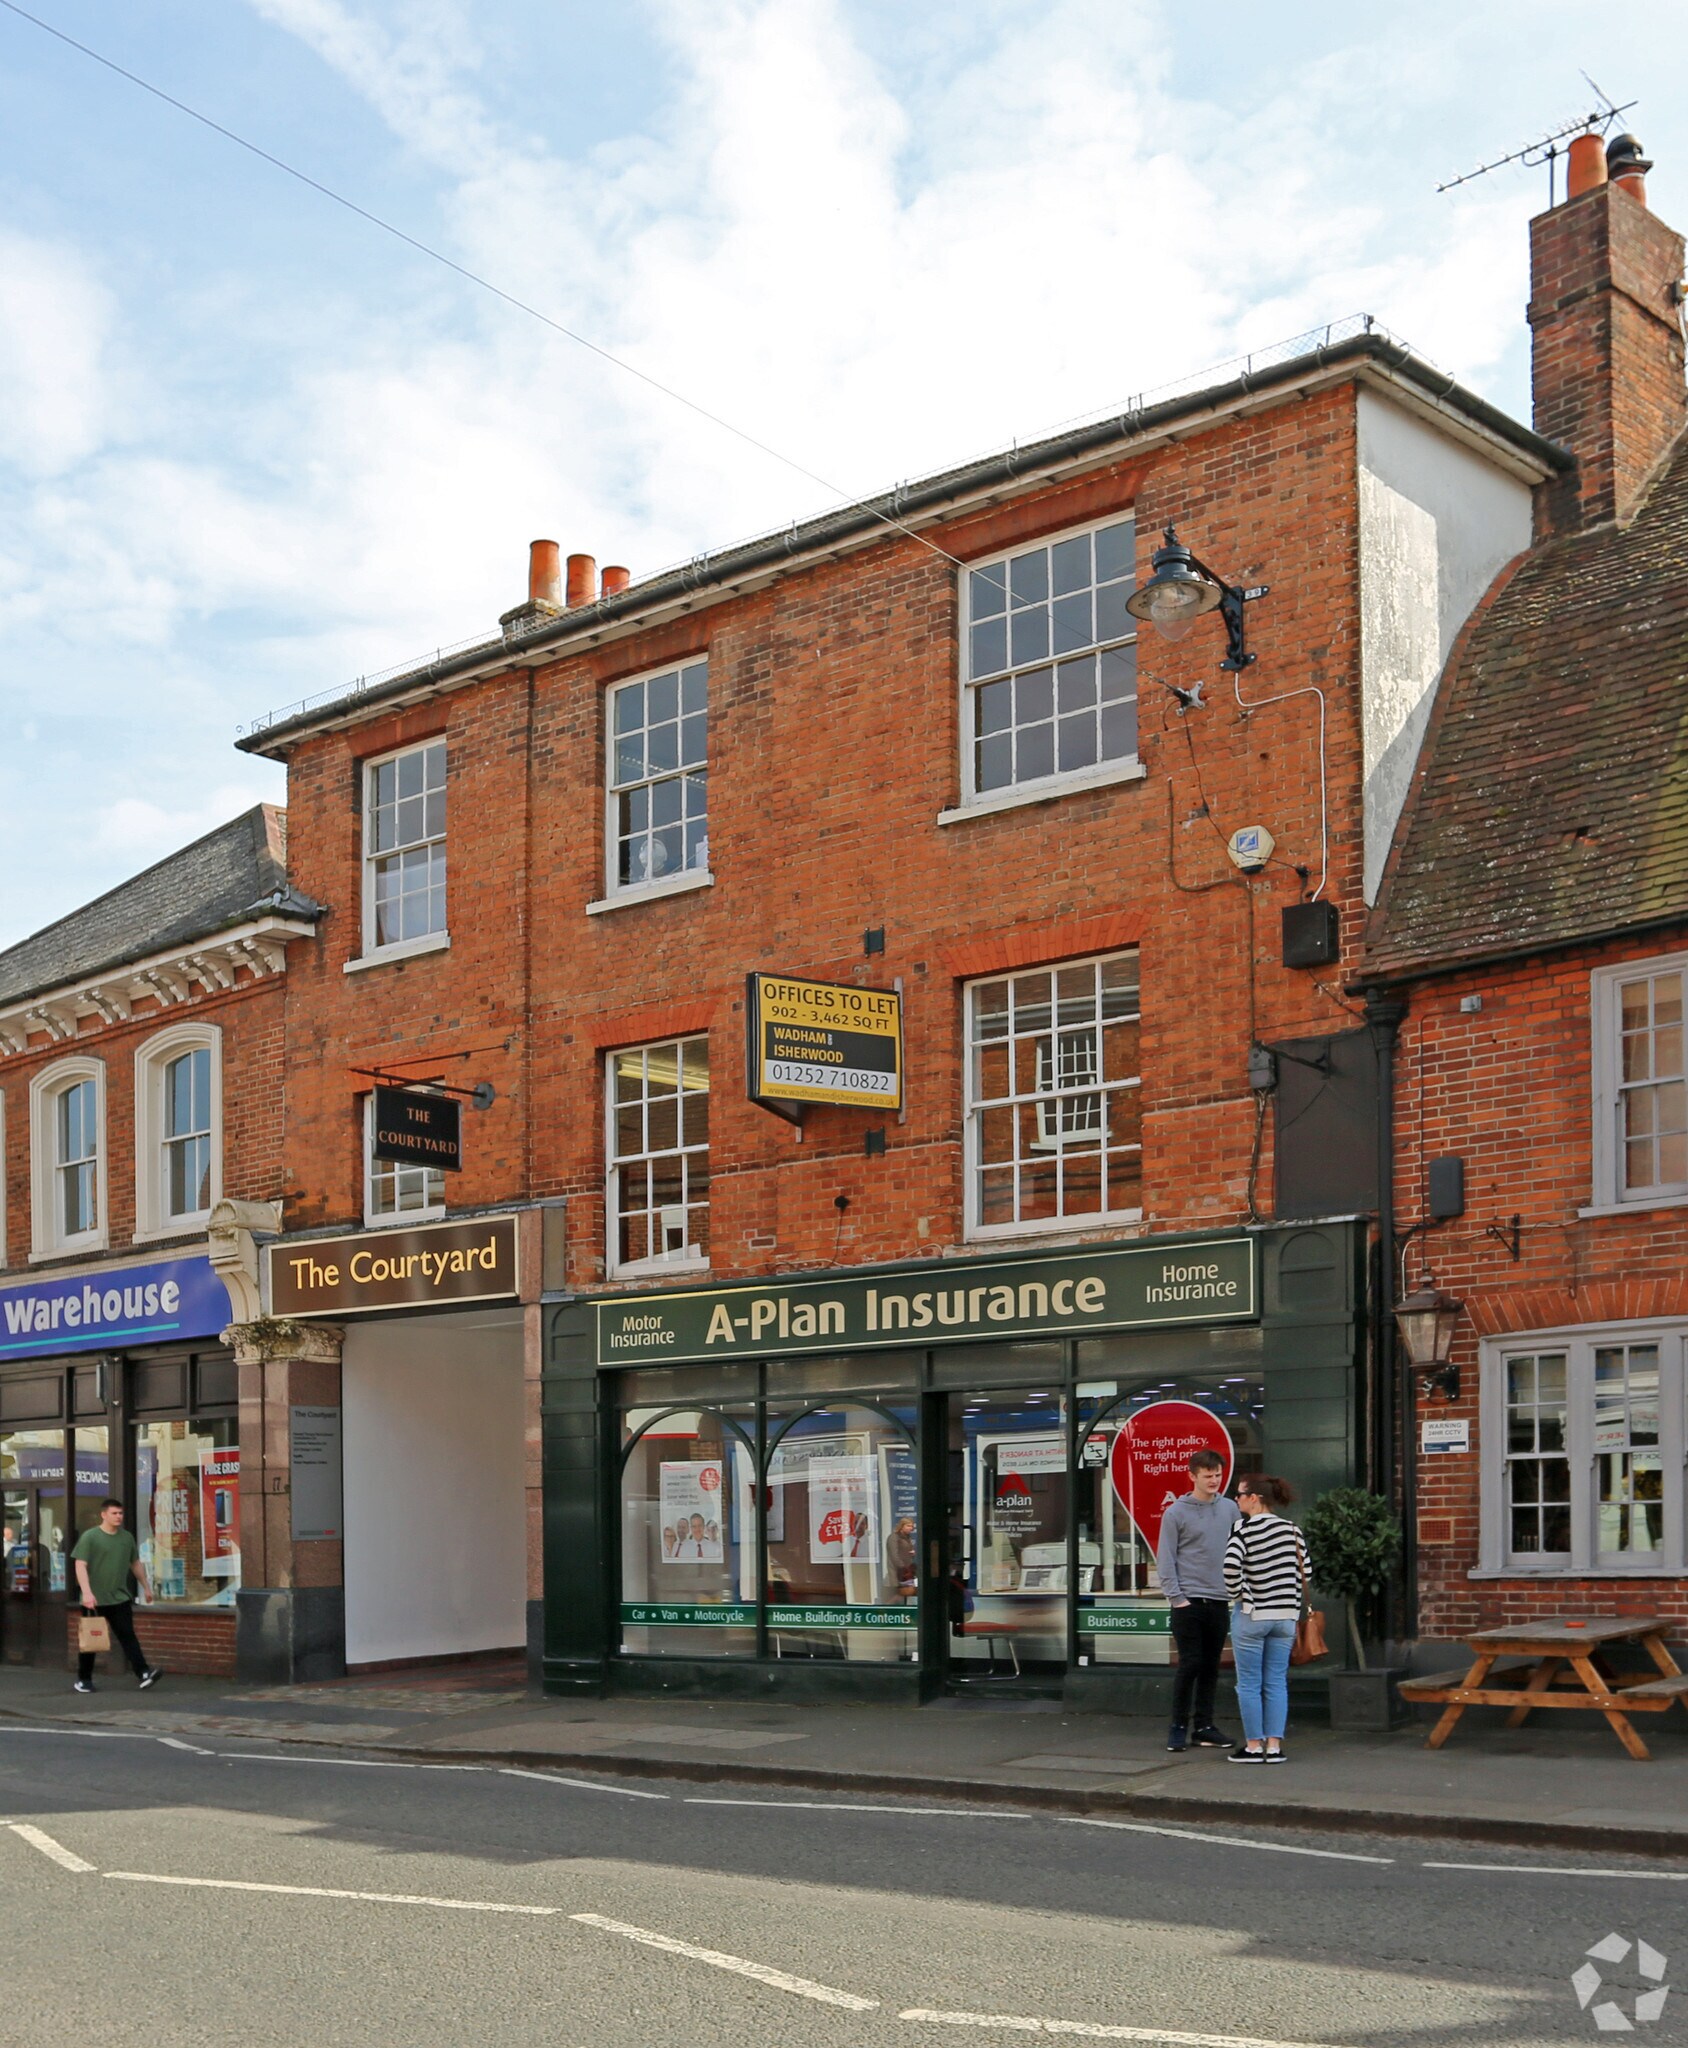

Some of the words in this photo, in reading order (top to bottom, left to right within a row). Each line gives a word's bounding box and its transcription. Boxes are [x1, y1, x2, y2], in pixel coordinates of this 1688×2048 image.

[764, 983, 835, 1007] OFFICES
[840, 993, 862, 1010] TO
[868, 997, 896, 1015] LET
[772, 1005, 798, 1019] 902
[810, 1011, 849, 1025] 3,462
[853, 1015, 872, 1030] SQ
[876, 1018, 890, 1030] FT
[773, 1026, 826, 1045] WADHAM
[773, 1044, 844, 1063] ISHERWOOD
[772, 1064, 824, 1085] 01252
[830, 1070, 889, 1091] 710822
[406, 1107, 431, 1124] THE
[378, 1130, 457, 1154] COURTYARD
[289, 1258, 340, 1290] The
[350, 1236, 497, 1286] Courtyard
[1162, 1263, 1218, 1284] Home
[1146, 1279, 1237, 1303] Insurance
[3, 1280, 181, 1335] Warehouse
[705, 1298, 846, 1345] A-Plan
[866, 1276, 1107, 1331] Insurance
[622, 1315, 663, 1332] Motor
[610, 1330, 675, 1348] Insurance
[1428, 1422, 1462, 1430] WARNING
[1131, 1438, 1150, 1449] The
[1152, 1437, 1174, 1449] right
[1177, 1435, 1209, 1447] policy.
[1133, 1451, 1152, 1461] The
[1154, 1450, 1177, 1462] right
[1143, 1463, 1169, 1475] Right
[154, 1488, 189, 1513] PRICE
[996, 1494, 1032, 1508] a-plan
[155, 1513, 189, 1534] CRASH
[632, 1609, 646, 1620] Car
[661, 1609, 678, 1620] Van
[694, 1609, 744, 1622] Motorcycle
[772, 1611, 802, 1622] Home
[805, 1611, 849, 1626] Buildings
[854, 1613, 861, 1623] &
[865, 1612, 911, 1624] Contents
[1087, 1614, 1138, 1628] Business
